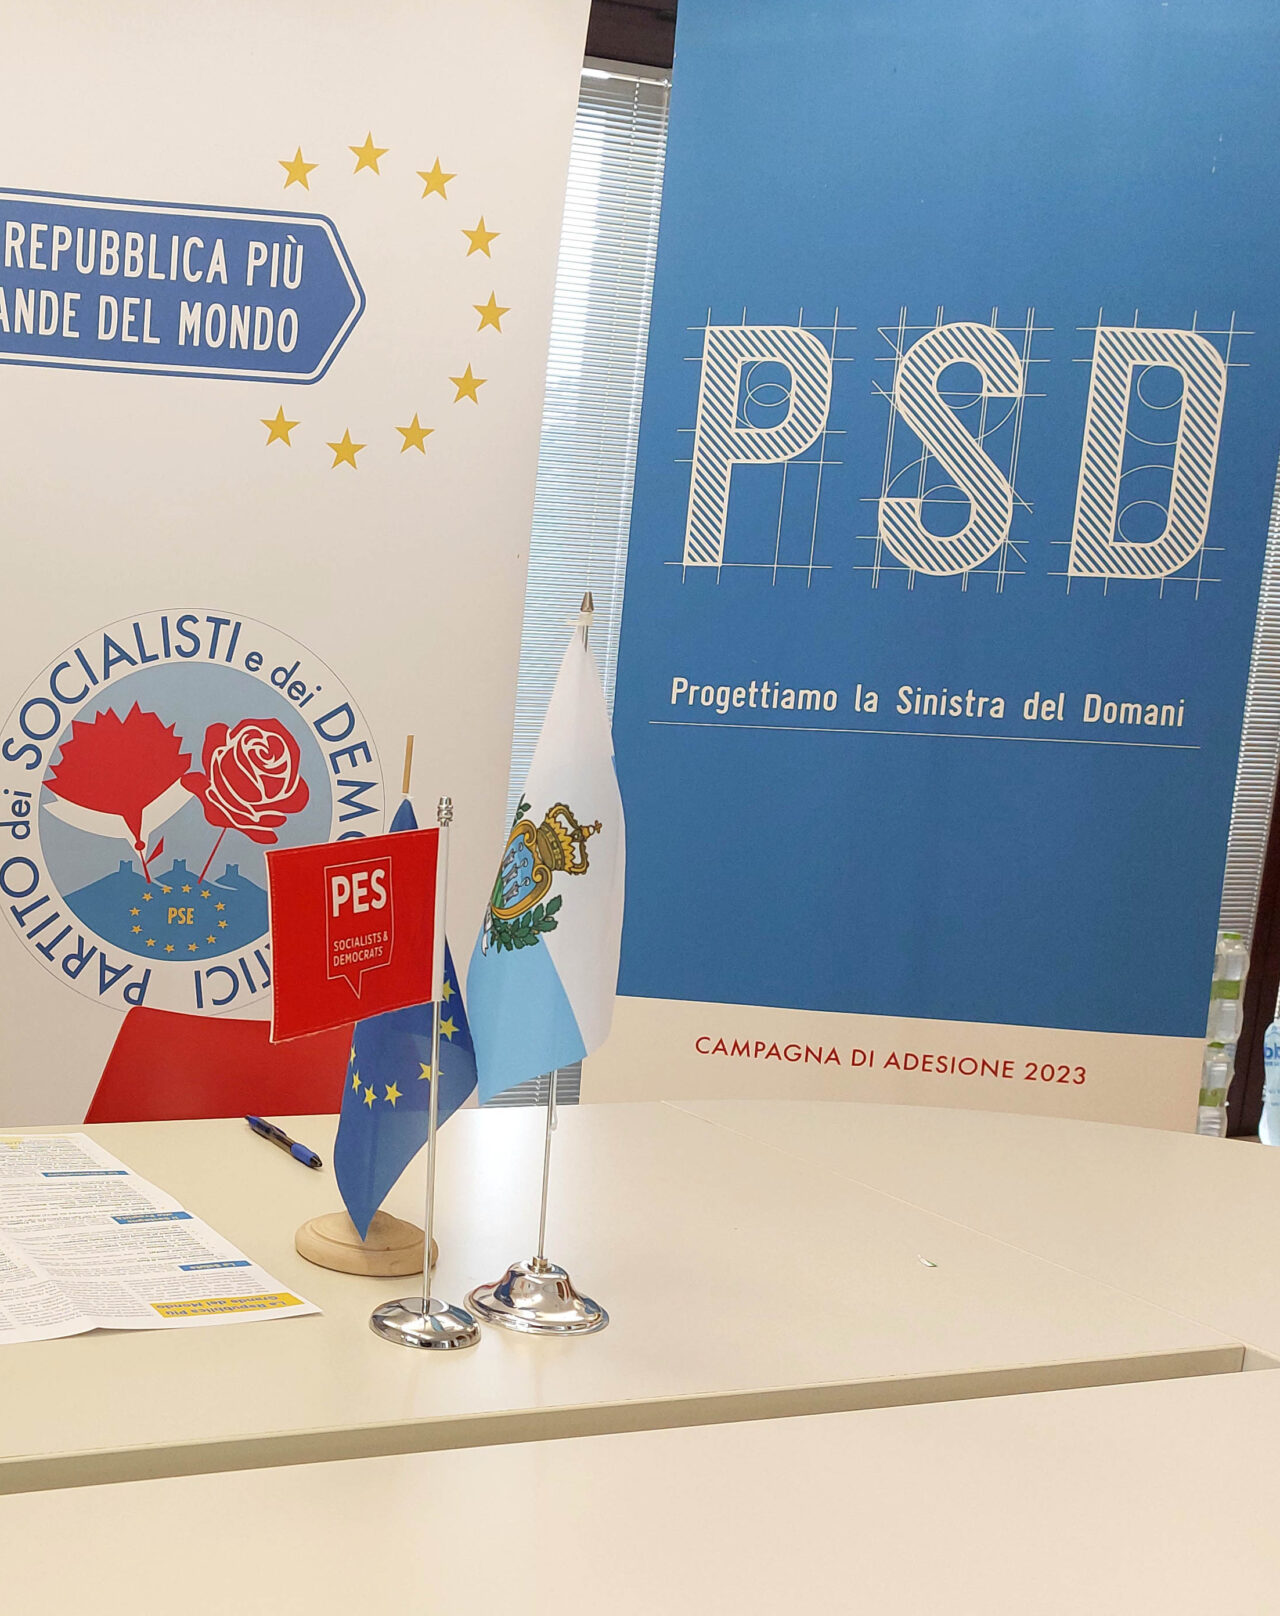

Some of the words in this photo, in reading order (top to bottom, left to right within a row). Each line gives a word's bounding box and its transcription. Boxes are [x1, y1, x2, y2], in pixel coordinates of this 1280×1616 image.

[4, 220, 228, 285] REPUBBLICA
[246, 234, 304, 290] PIÙ
[97, 294, 161, 344] DEL
[177, 301, 300, 354] MONDO
[683, 321, 1227, 579] PSD
[1, 614, 242, 771] SOCIALISTI
[244, 650, 264, 673] e
[270, 661, 323, 709] dei
[670, 676, 839, 714] Progettiamo
[854, 683, 879, 713] la
[896, 685, 1007, 719] Sinistra
[1023, 690, 1065, 722] del
[1083, 693, 1186, 727] Domani
[167, 907, 195, 925] PSE
[331, 868, 387, 918] PES
[333, 932, 382, 952] SOCIALISTS
[333, 946, 384, 967] DEMOCRATS
[695, 1036, 841, 1066] CAMPAGNA
[851, 1048, 875, 1068] DI
[883, 1050, 1015, 1079] ADESIONE
[1023, 1062, 1088, 1086] 2023
